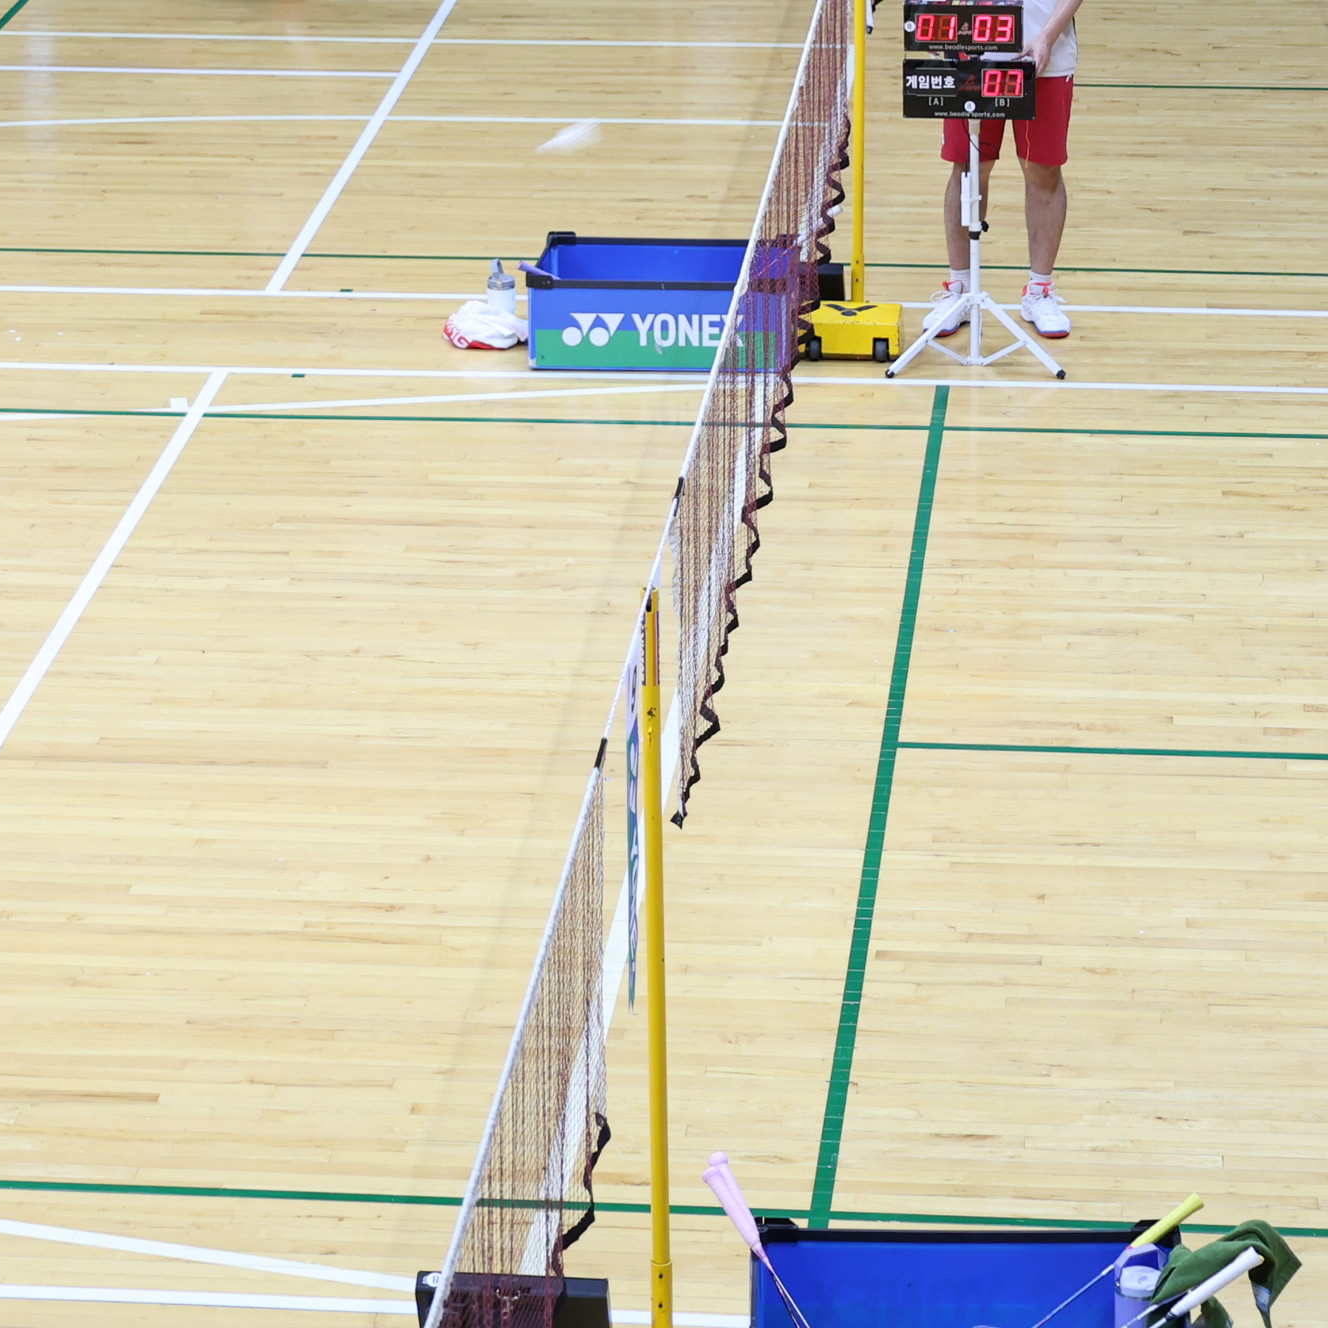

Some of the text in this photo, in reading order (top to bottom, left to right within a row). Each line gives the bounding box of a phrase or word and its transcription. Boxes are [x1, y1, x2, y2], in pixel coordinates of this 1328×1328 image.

[916, 14, 957, 41] 01
[972, 15, 1013, 42] 03
[929, 43, 998, 51] www.beodlesports.com
[906, 70, 1024, 97] 게임번호 07
